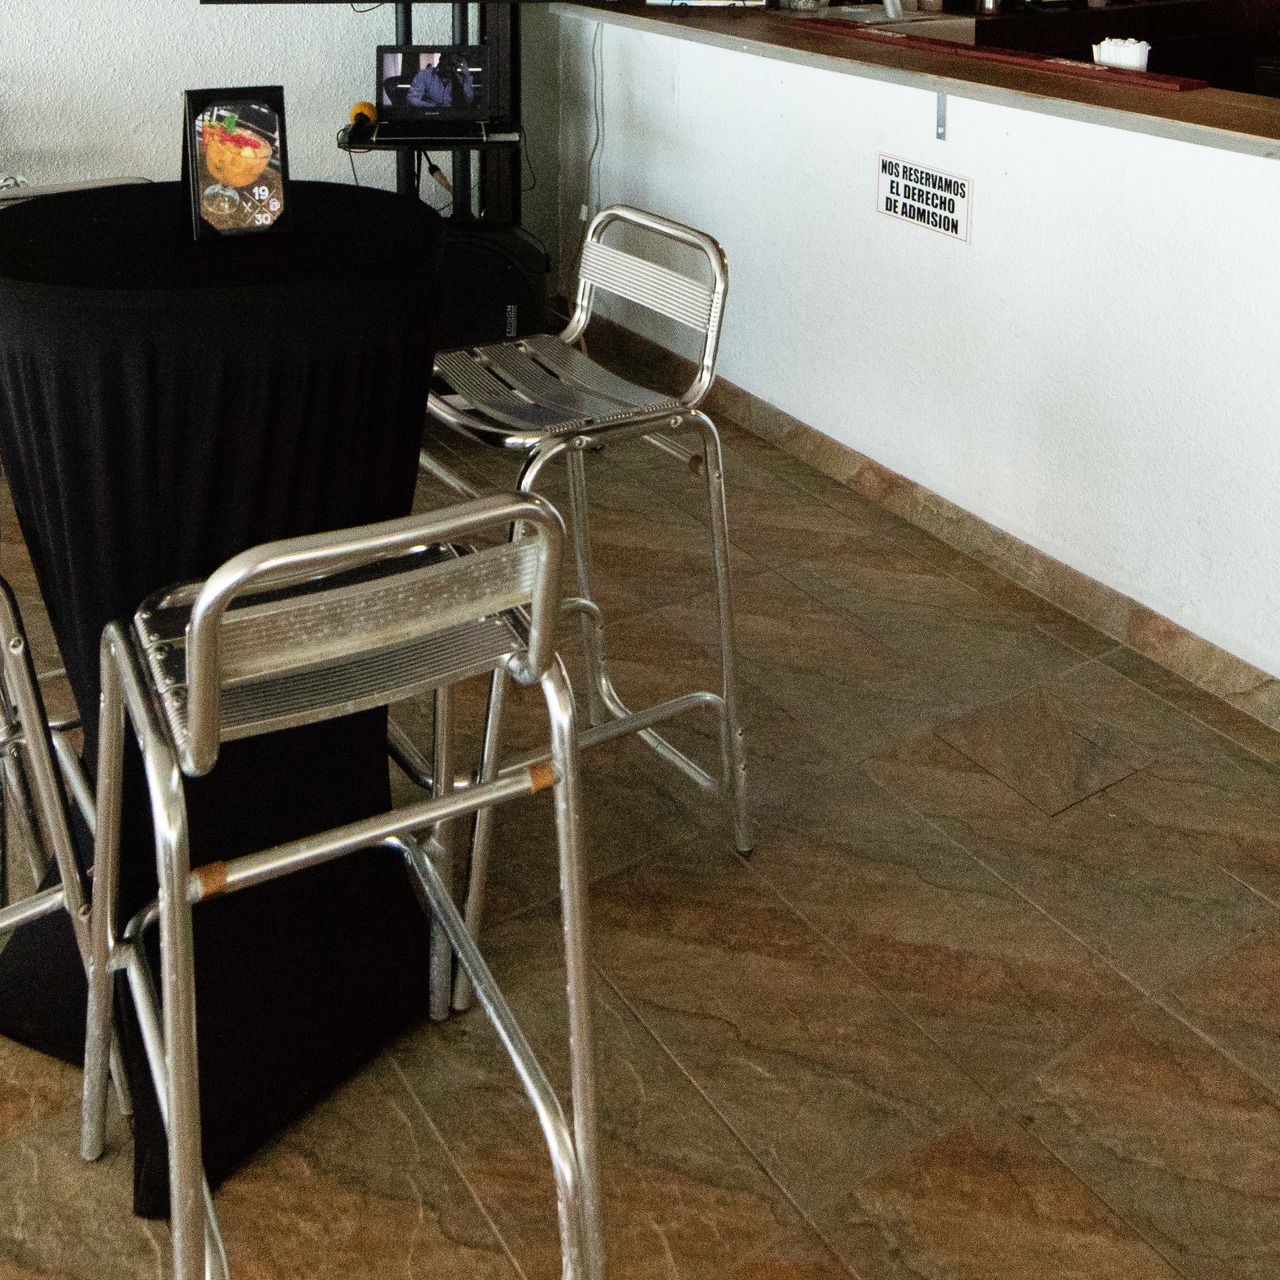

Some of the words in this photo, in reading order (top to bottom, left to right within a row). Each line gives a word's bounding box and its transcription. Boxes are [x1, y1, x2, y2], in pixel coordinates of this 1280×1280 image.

[253, 186, 269, 200] 19
[881, 159, 900, 177] NOS
[902, 164, 966, 199] RESERVAMOS
[890, 180, 900, 196] EL
[903, 184, 956, 214] DERECHO
[886, 197, 898, 213] DE
[901, 202, 959, 235] ADMISION
